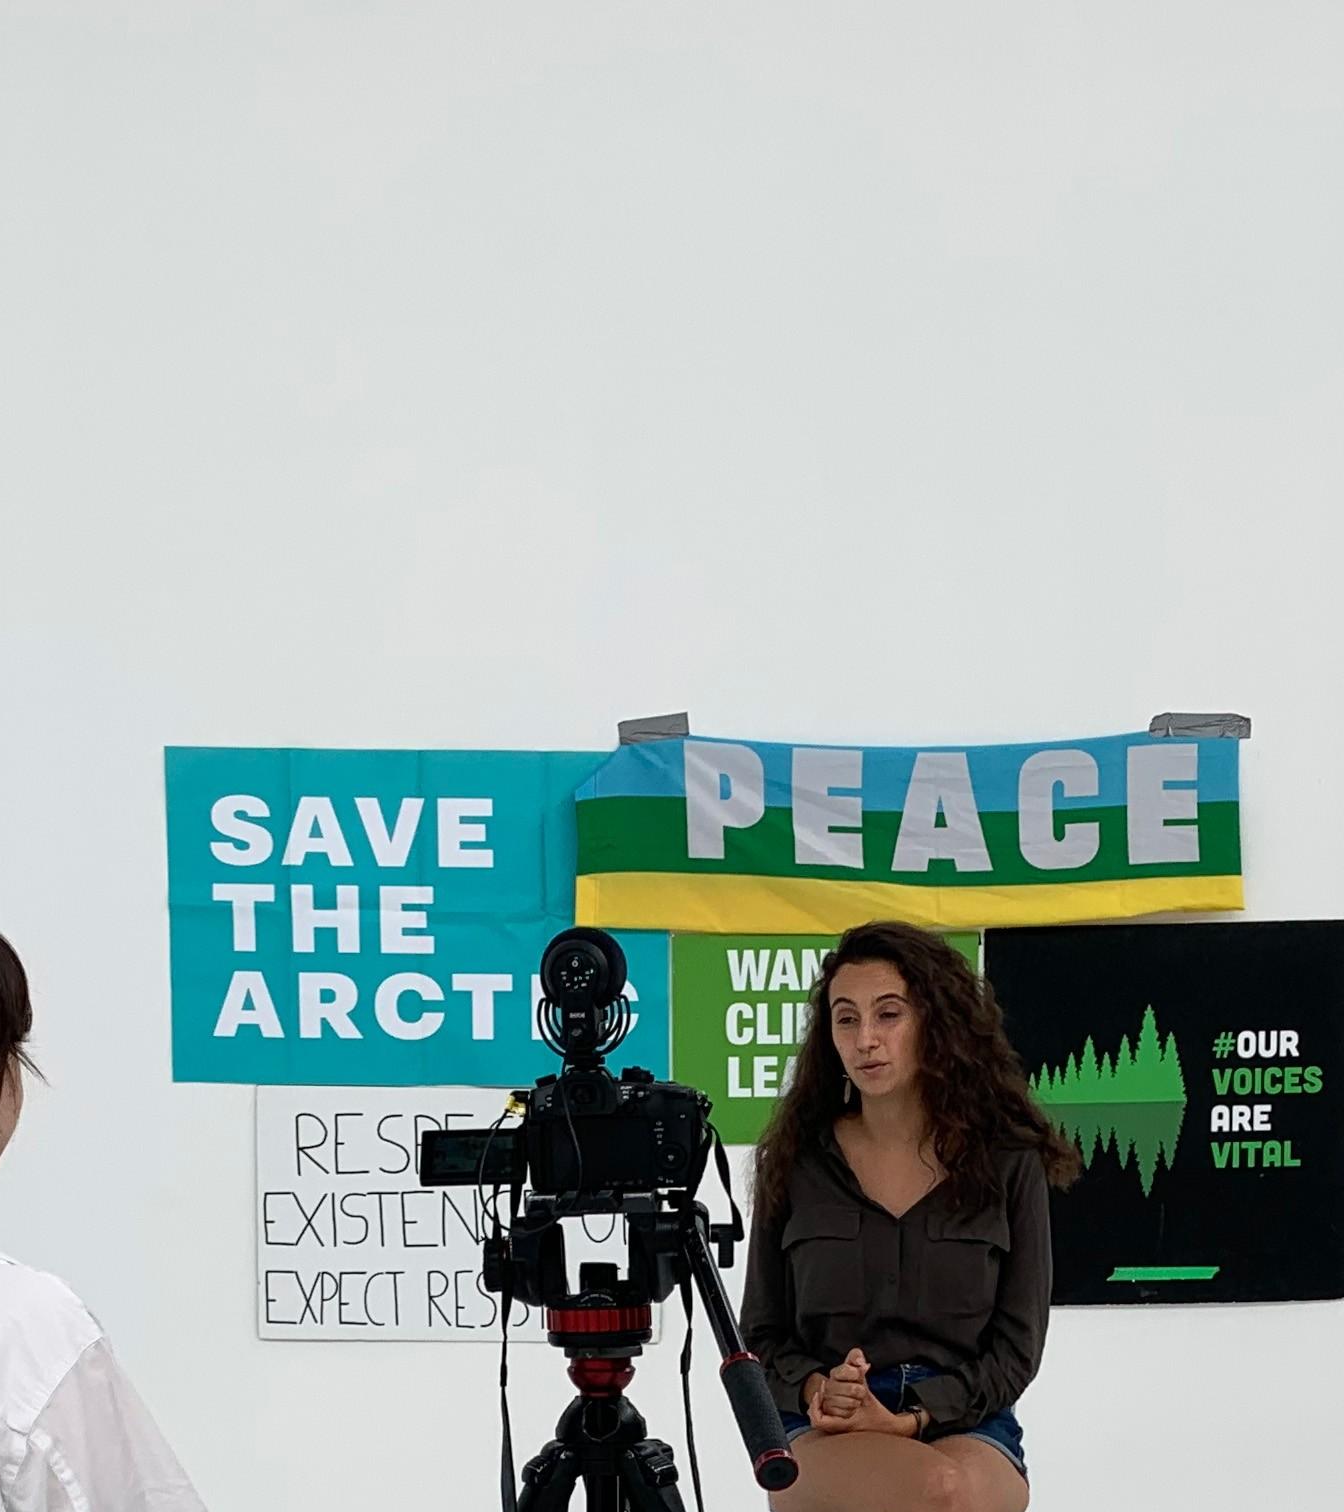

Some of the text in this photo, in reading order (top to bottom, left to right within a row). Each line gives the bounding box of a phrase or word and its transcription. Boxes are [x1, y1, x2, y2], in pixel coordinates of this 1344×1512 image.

[209, 794, 495, 869] SAVE
[683, 739, 1200, 873] PEACE
[212, 883, 436, 955] THE
[726, 948, 831, 993] WAN
[1212, 1030, 1300, 1059] #OUR
[1211, 1065, 1324, 1096] VOICES
[295, 1112, 514, 1177] RESP
[1210, 1104, 1273, 1133] ARE
[1210, 1140, 1302, 1169] VITAL
[263, 1187, 532, 1248] EXISTENC
[265, 1270, 405, 1327] EXPECT
